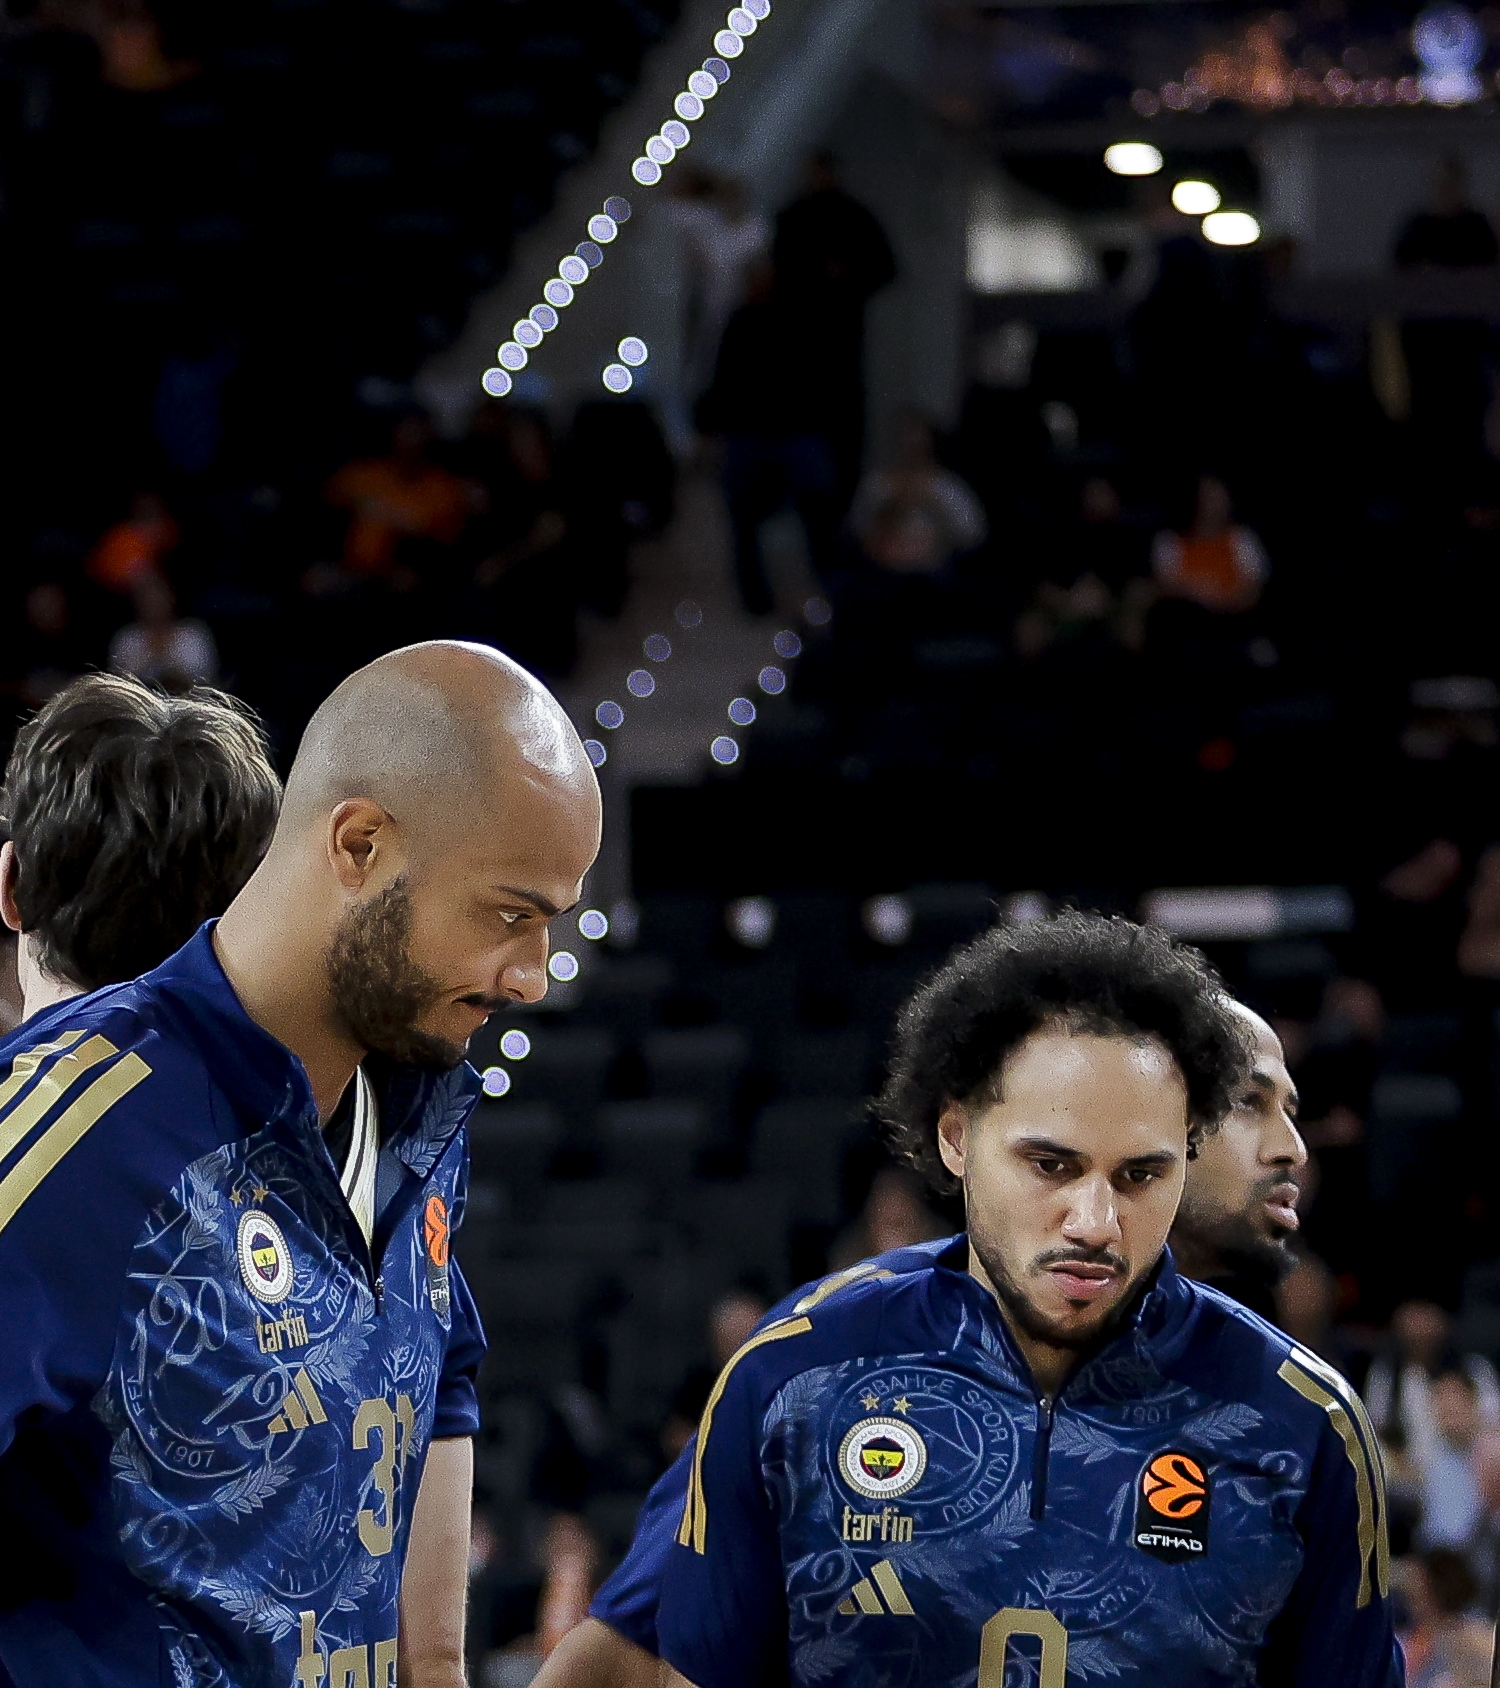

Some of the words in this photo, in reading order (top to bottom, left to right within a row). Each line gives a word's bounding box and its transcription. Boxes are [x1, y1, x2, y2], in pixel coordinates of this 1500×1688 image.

[255, 1311, 310, 1356] tarfin
[842, 1505, 914, 1543] tarfin
[1137, 1533, 1203, 1551] ETIHAD
